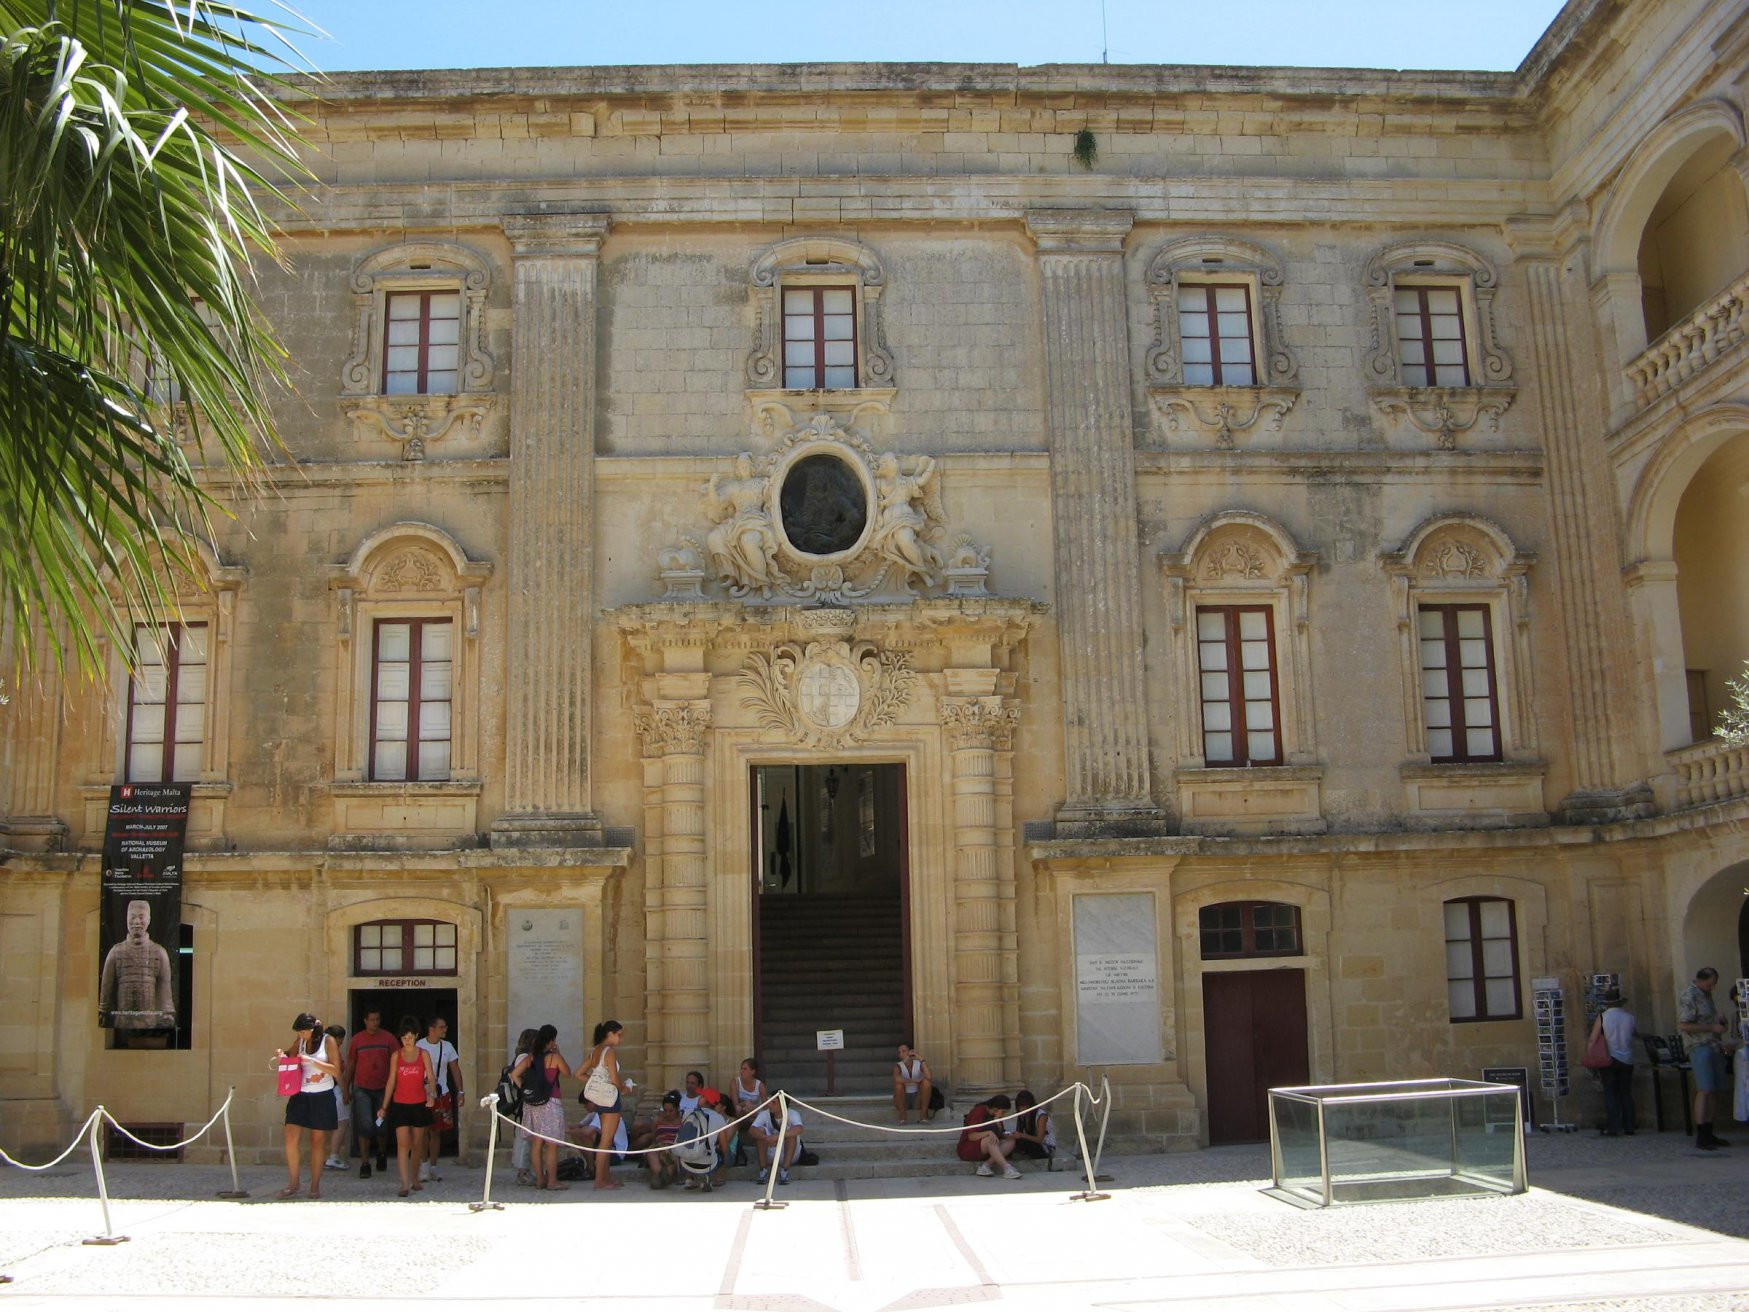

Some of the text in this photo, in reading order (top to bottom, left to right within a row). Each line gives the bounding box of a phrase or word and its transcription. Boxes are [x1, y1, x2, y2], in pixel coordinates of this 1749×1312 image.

[134, 788, 161, 797] Heritage
[162, 788, 181, 796] Malta
[110, 803, 143, 813] Silent
